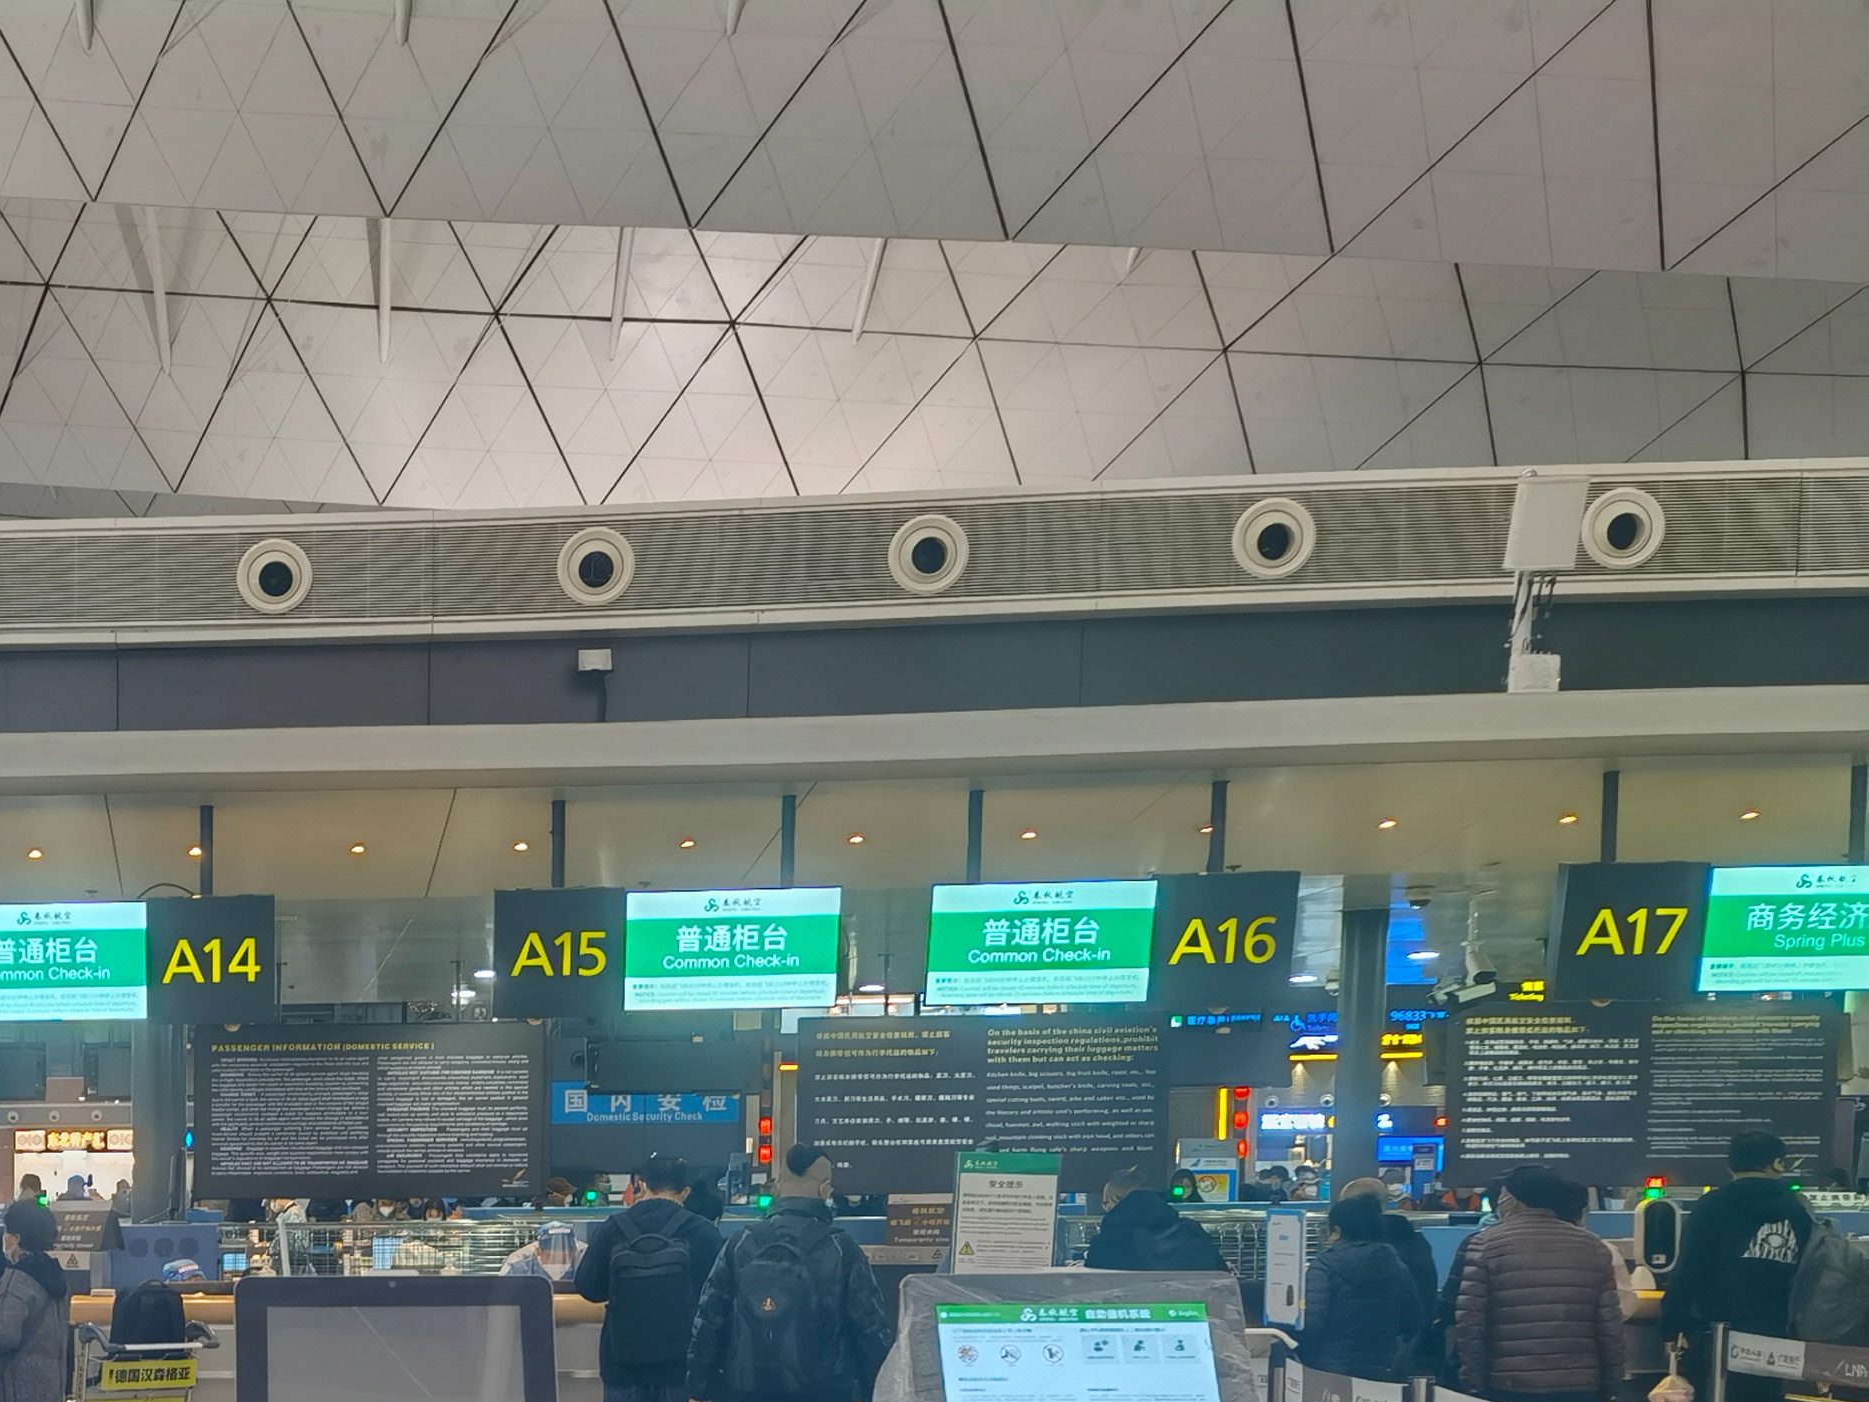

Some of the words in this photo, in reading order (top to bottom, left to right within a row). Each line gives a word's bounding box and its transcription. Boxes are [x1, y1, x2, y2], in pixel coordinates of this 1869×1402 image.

[676, 923, 788, 952] 普通柜台
[983, 916, 1100, 947] 普通柜台
[1576, 907, 1688, 956] A17
[1168, 916, 1277, 965] A16
[1774, 934, 1825, 951] Spring
[1831, 933, 1865, 947] Plus
[162, 938, 261, 984] A14
[511, 931, 606, 977] A15
[663, 956, 729, 970] Common
[734, 953, 800, 968] Check-in
[968, 949, 1038, 963] Common
[1042, 947, 1110, 962] Check-in
[48, 966, 111, 980] Check-in
[1389, 1010, 1427, 1022] 96833
[987, 1028, 1000, 1038] On
[1002, 1028, 1016, 1037] the
[1017, 1027, 1040, 1037] basis
[1042, 1027, 1051, 1036] of
[1052, 1027, 1067, 1036] the
[1068, 1026, 1092, 1036] china
[1094, 1026, 1113, 1035] civil
[1114, 1025, 1157, 1034] aviation's
[212, 1044, 271, 1052] PASSENGER
[272, 1043, 342, 1052] INFORMATION
[392, 1042, 430, 1051] SERVICE
[987, 1038, 1022, 1047] security
[1023, 1037, 1069, 1046] inspection
[987, 1047, 1026, 1056] travelers
[1027, 1046, 1063, 1055] carrying
[1065, 1045, 1086, 1054] their
[1087, 1044, 1122, 1054] luggage
[1123, 1043, 1158, 1053] matters
[987, 1056, 1007, 1065] with
[1008, 1055, 1031, 1064] them
[1032, 1055, 1047, 1064] but
[1048, 1054, 1064, 1064] can
[1066, 1054, 1079, 1063] act
[1081, 1054, 1091, 1063] as
[587, 1111, 631, 1122] Domestic
[632, 1111, 673, 1123] Security
[674, 1110, 703, 1121] Check
[115, 1366, 191, 1383] 德国汉森格亚
